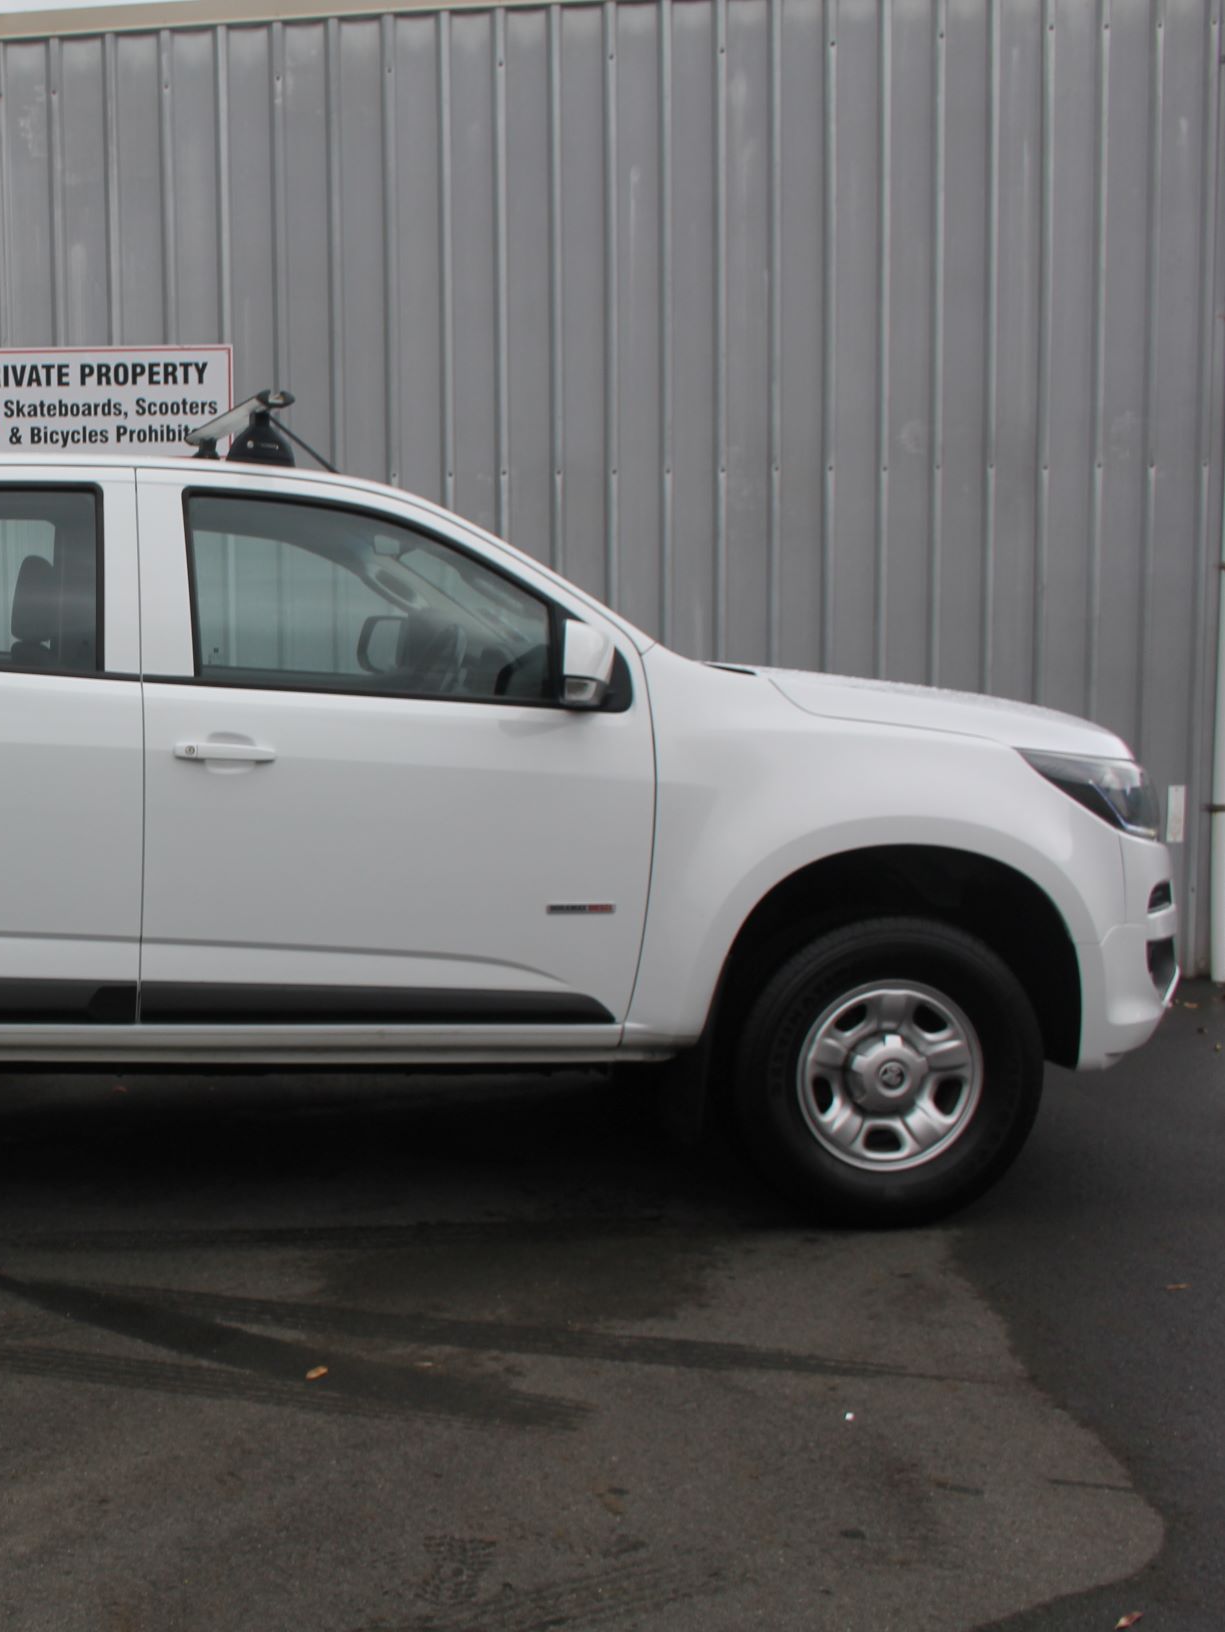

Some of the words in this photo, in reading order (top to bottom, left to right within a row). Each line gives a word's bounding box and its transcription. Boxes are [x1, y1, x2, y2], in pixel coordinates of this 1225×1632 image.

[79, 361, 208, 386] PROPERTY
[3, 398, 128, 419] Skateboards,
[135, 396, 218, 416] Scooters
[8, 426, 22, 444] &
[30, 425, 109, 449] Bicycles
[116, 423, 199, 444] Prohibit
